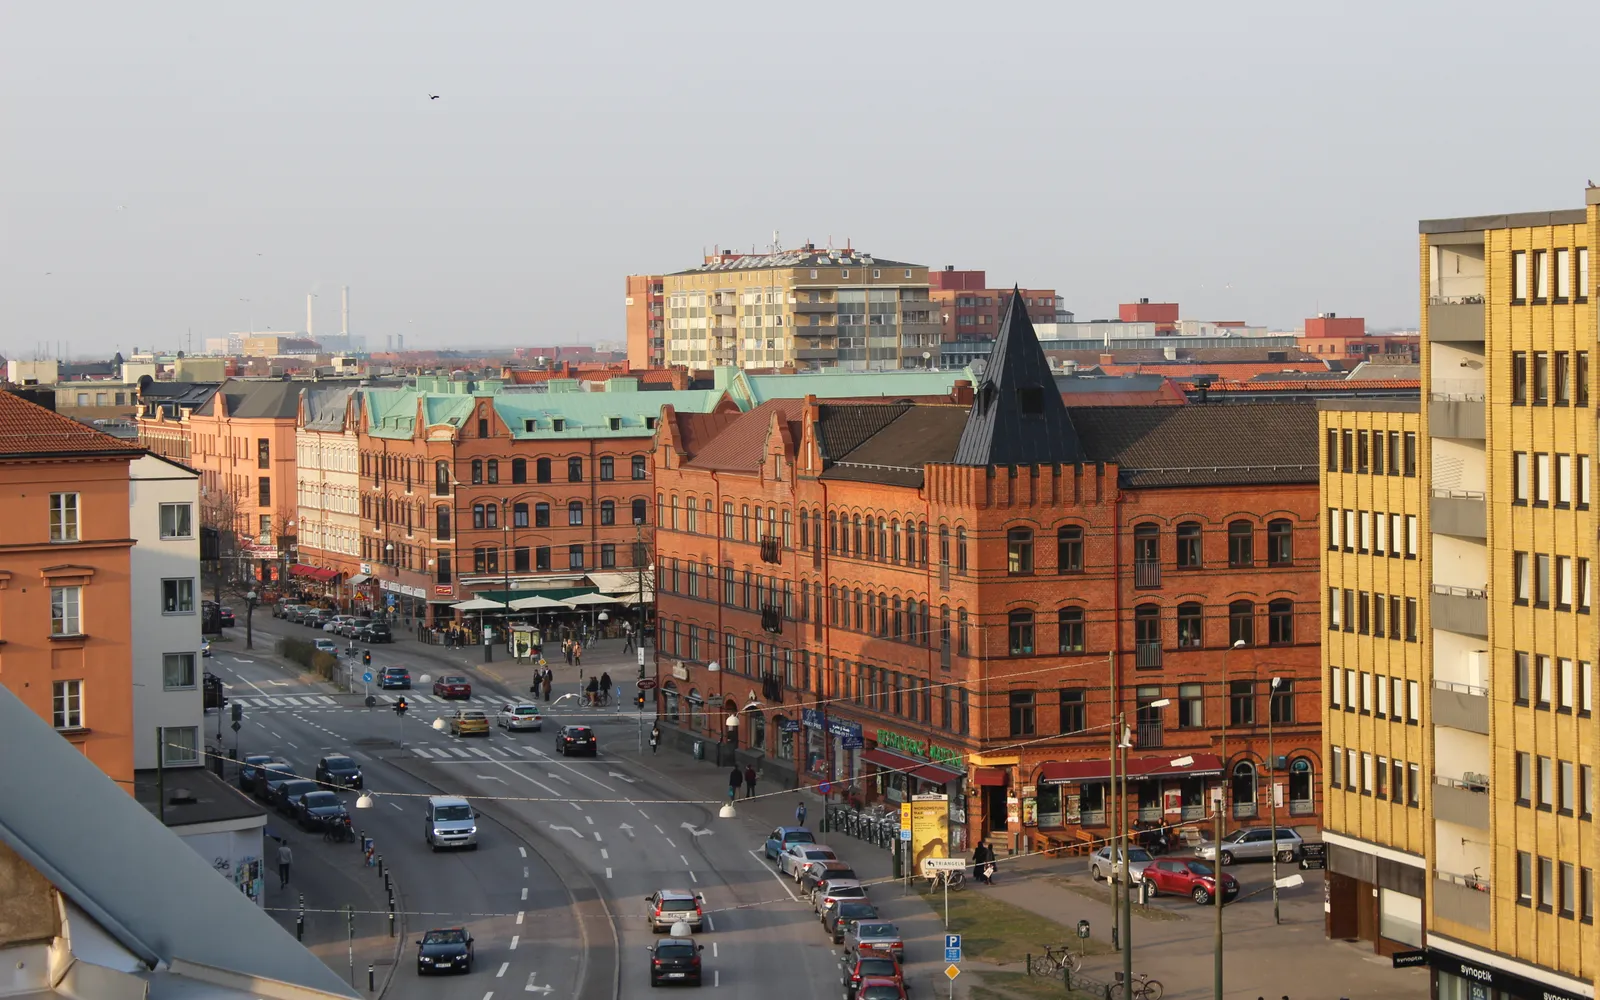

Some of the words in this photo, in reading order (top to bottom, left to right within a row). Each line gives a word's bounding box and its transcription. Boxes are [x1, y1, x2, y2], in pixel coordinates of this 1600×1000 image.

[950, 936, 957, 947] P
[1397, 955, 1423, 963] synoptik
[1460, 964, 1492, 981] synoptik
[1472, 987, 1485, 999] SOL
